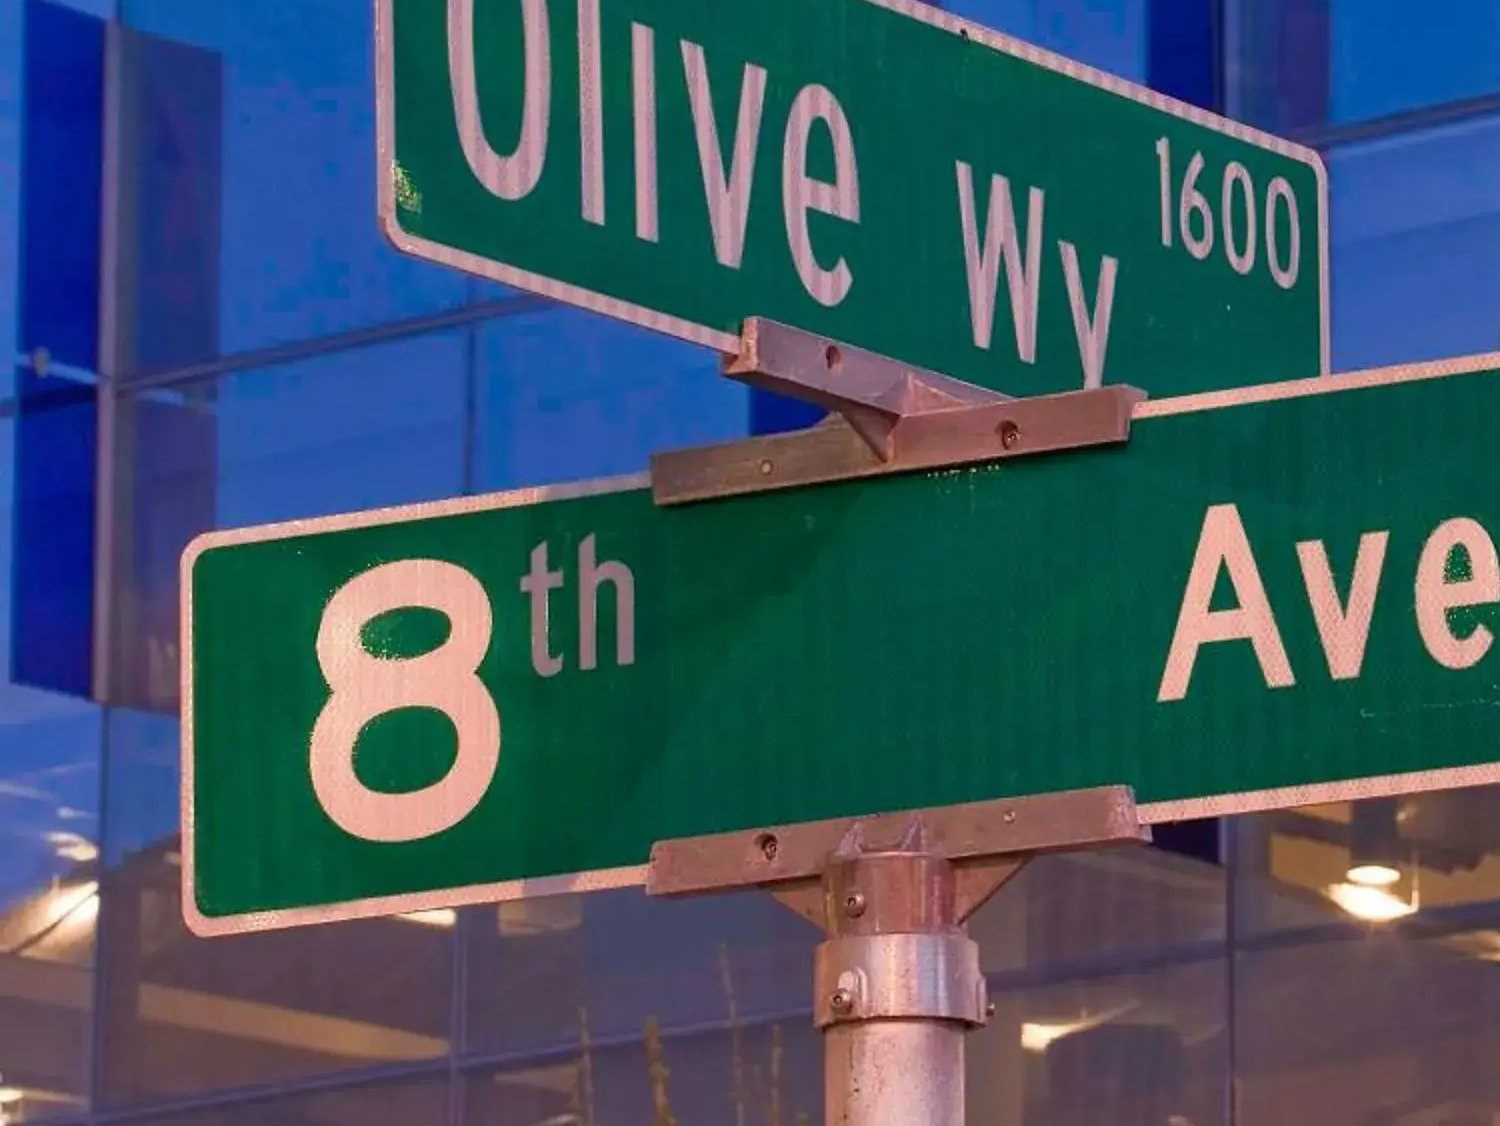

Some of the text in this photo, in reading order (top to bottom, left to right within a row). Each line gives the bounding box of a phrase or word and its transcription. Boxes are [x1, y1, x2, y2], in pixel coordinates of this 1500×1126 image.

[954, 159, 1119, 390] Wy
[1155, 136, 1301, 290] 1600
[309, 531, 636, 844] 8th
